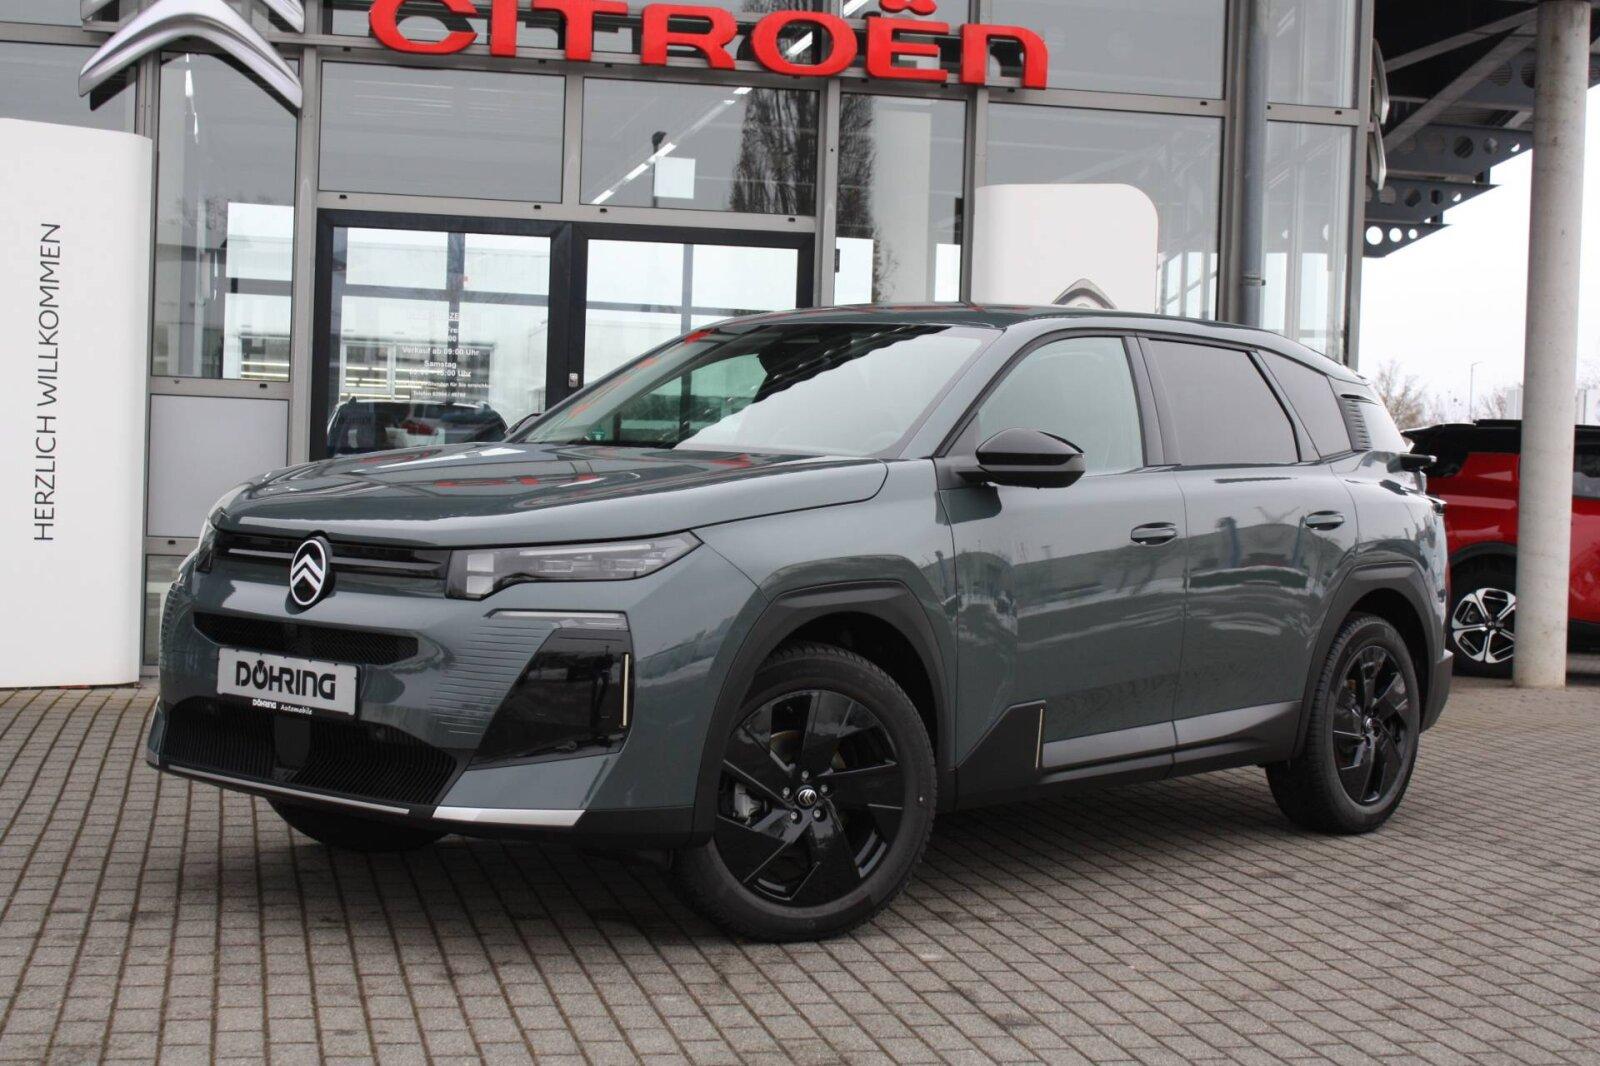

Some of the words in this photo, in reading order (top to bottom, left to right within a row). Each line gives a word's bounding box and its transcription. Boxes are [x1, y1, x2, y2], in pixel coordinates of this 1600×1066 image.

[37, 223, 61, 407] WILLKOMMEN
[402, 346, 430, 354] Verkauf
[465, 348, 480, 356] Uhr
[424, 360, 457, 370] Samstag
[34, 416, 56, 541] HERZLICH
[235, 660, 336, 700] DÖHRING
[280, 704, 312, 715] Automobile
